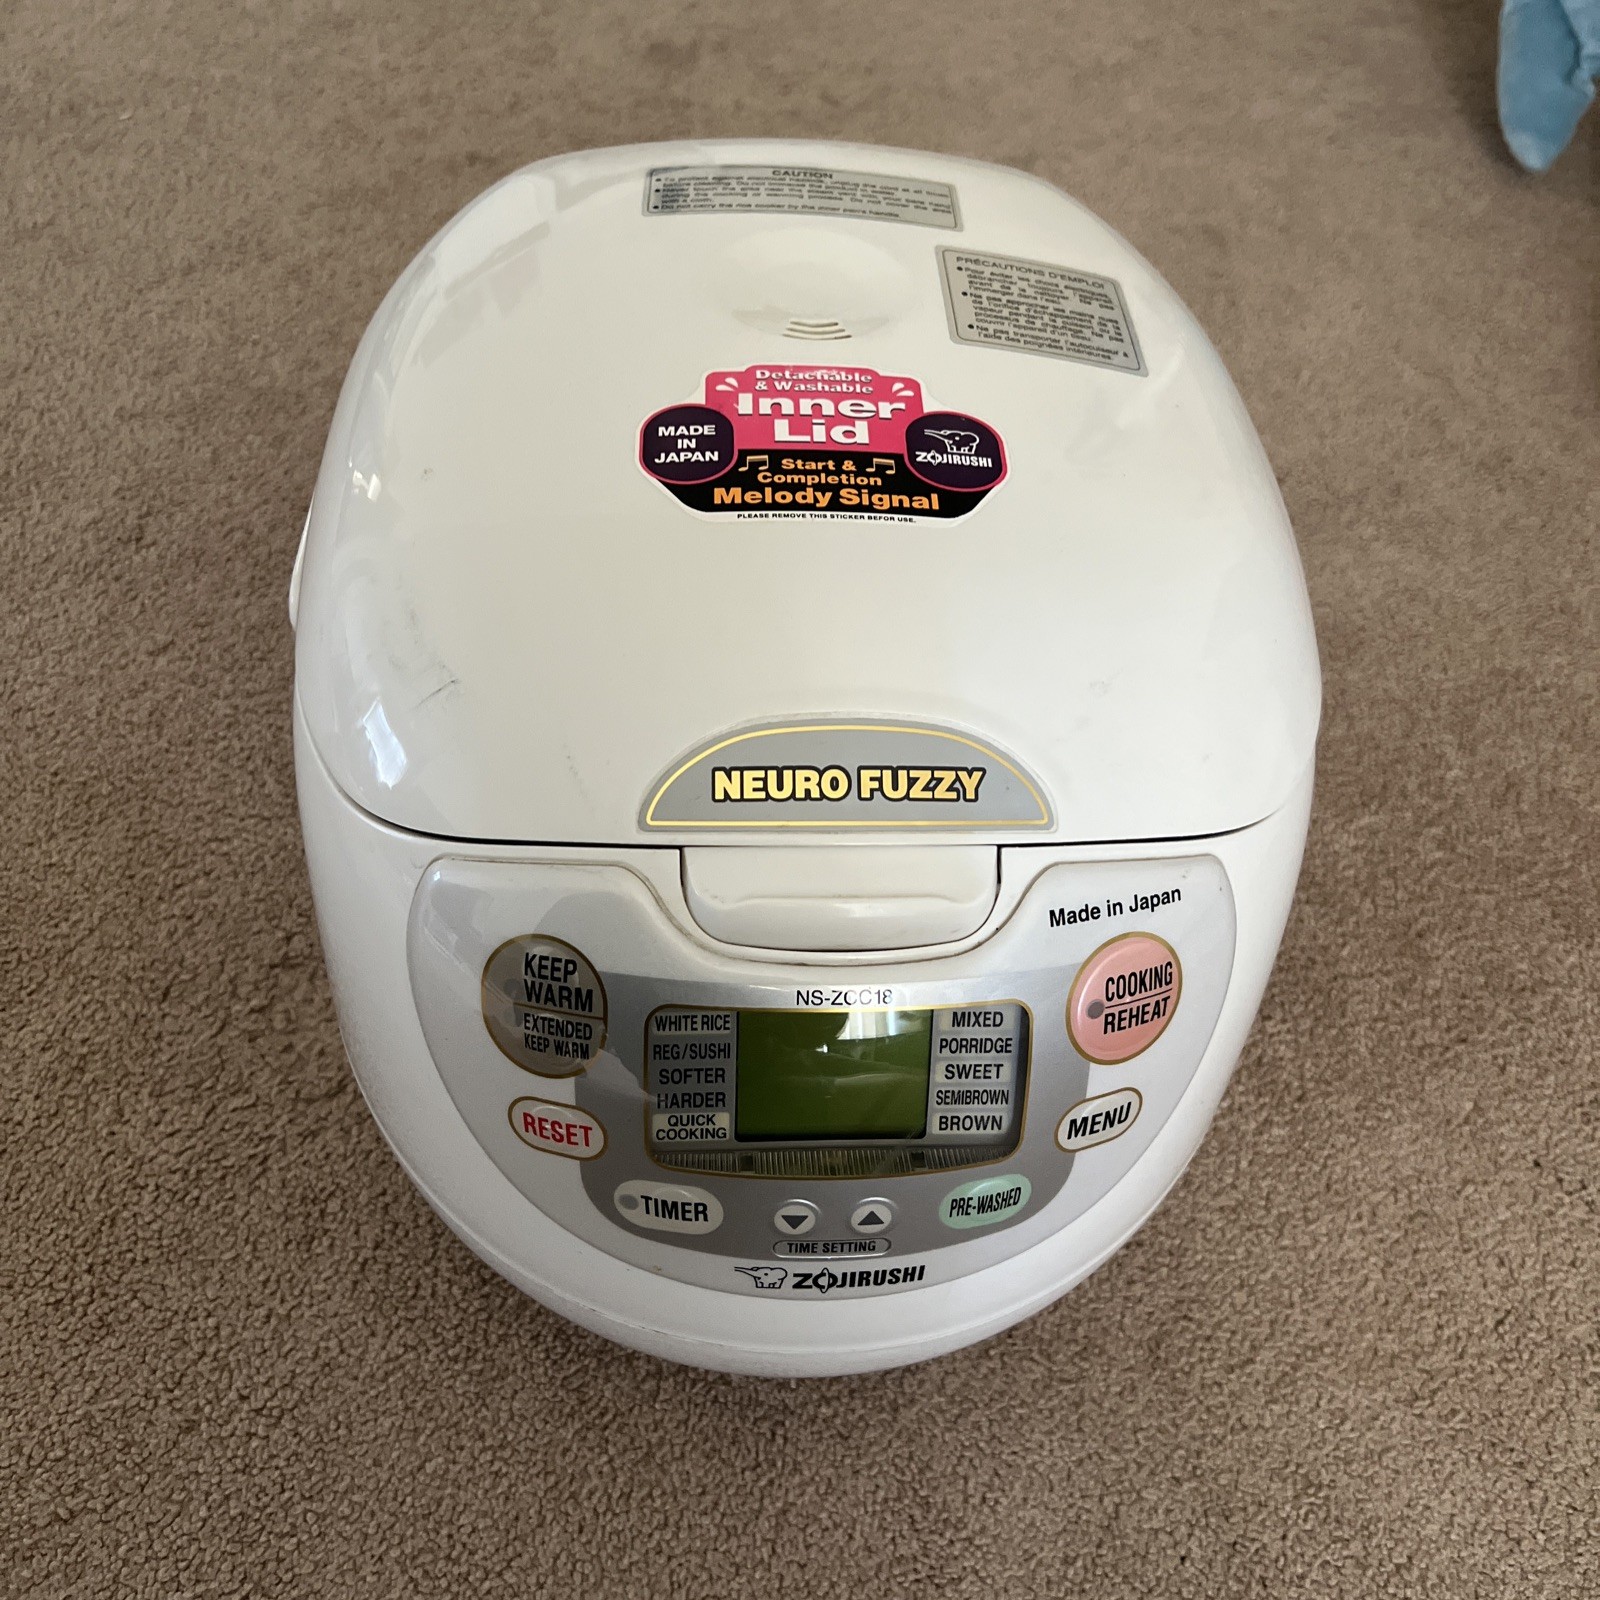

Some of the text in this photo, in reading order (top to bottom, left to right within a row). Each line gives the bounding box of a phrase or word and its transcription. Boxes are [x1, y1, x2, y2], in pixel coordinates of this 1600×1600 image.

[772, 170, 833, 179] CAUTION
[956, 256, 1104, 289] PRÉCAUTIONS D'EMPLOI
[756, 370, 872, 383] Detachable
[756, 381, 873, 394] & Washable
[738, 393, 905, 419] Inner
[658, 425, 716, 437] MADE
[774, 419, 870, 444] Lid
[677, 438, 696, 449] IN
[654, 451, 719, 464] JAPAN
[781, 458, 856, 471] Start &
[915, 451, 993, 468] ZOJIRUSHI
[757, 473, 882, 486] Completion
[714, 487, 939, 510] Melody Signal
[713, 766, 985, 801] NEURO FUZZY
[1049, 888, 1181, 928] Made in Japan
[524, 952, 577, 983] KEEP
[1105, 961, 1173, 1001] COOKING
[524, 979, 593, 1013] WARM
[797, 989, 892, 1005] NS-ZCC18
[655, 1014, 730, 1032] WHITE RICE
[952, 1011, 1003, 1028] MIXED
[1103, 996, 1170, 1034] REHEAT
[524, 1013, 592, 1040] EXTENDED
[524, 1033, 589, 1060] KEEP WARM
[939, 1038, 1013, 1053] PORRIDGE
[659, 1068, 725, 1084] SOFTER
[944, 1064, 1003, 1080] SWEET
[657, 1092, 726, 1109] HARDER
[936, 1089, 1009, 1105] SEMIBROWN
[523, 1112, 592, 1147] RESET
[668, 1115, 716, 1128] QUICK
[939, 1115, 1002, 1131] BROWN
[1067, 1102, 1132, 1140] MENU
[656, 1127, 727, 1141] COOKING
[640, 1195, 708, 1222] TIMER
[949, 1187, 1021, 1218] PRE-WASHED
[787, 1240, 876, 1253] TIME SETTING
[792, 1265, 925, 1293] ZOJIRUSHI
